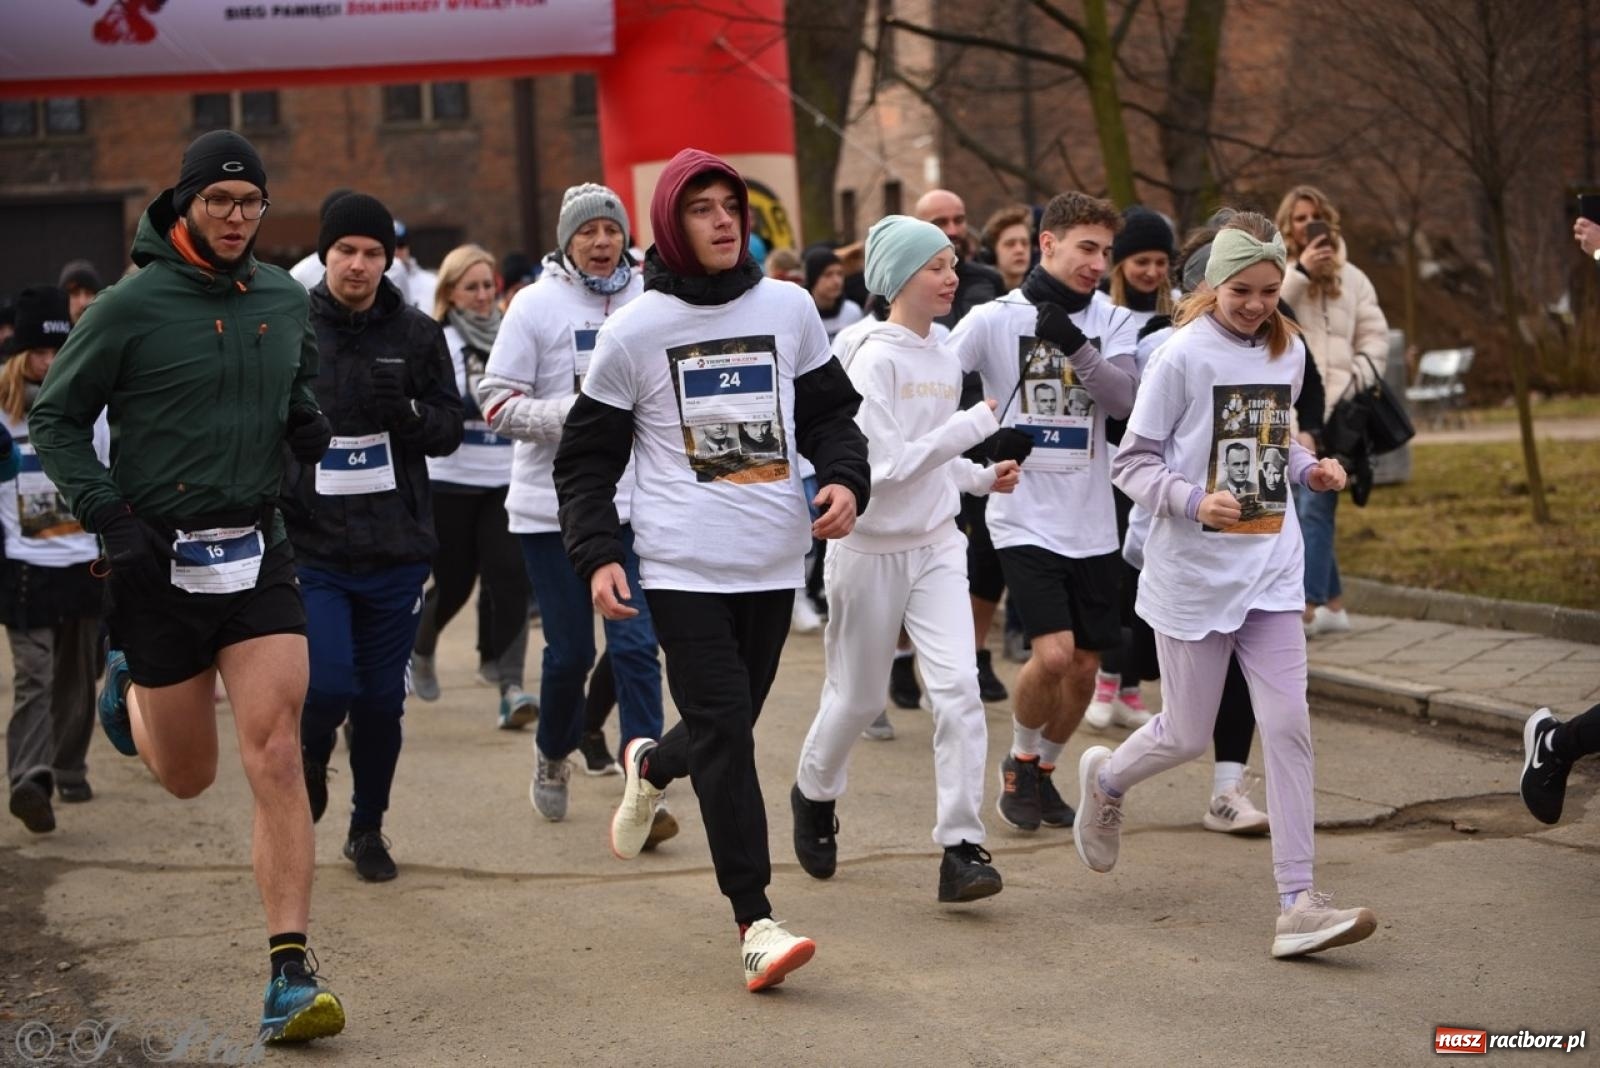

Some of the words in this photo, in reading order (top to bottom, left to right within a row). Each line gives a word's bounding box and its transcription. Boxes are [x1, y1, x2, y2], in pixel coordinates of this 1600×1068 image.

[225, 6, 266, 20] BIEG
[719, 371, 741, 389] 24
[1042, 430, 1060, 443] 74
[348, 450, 367, 466] 64
